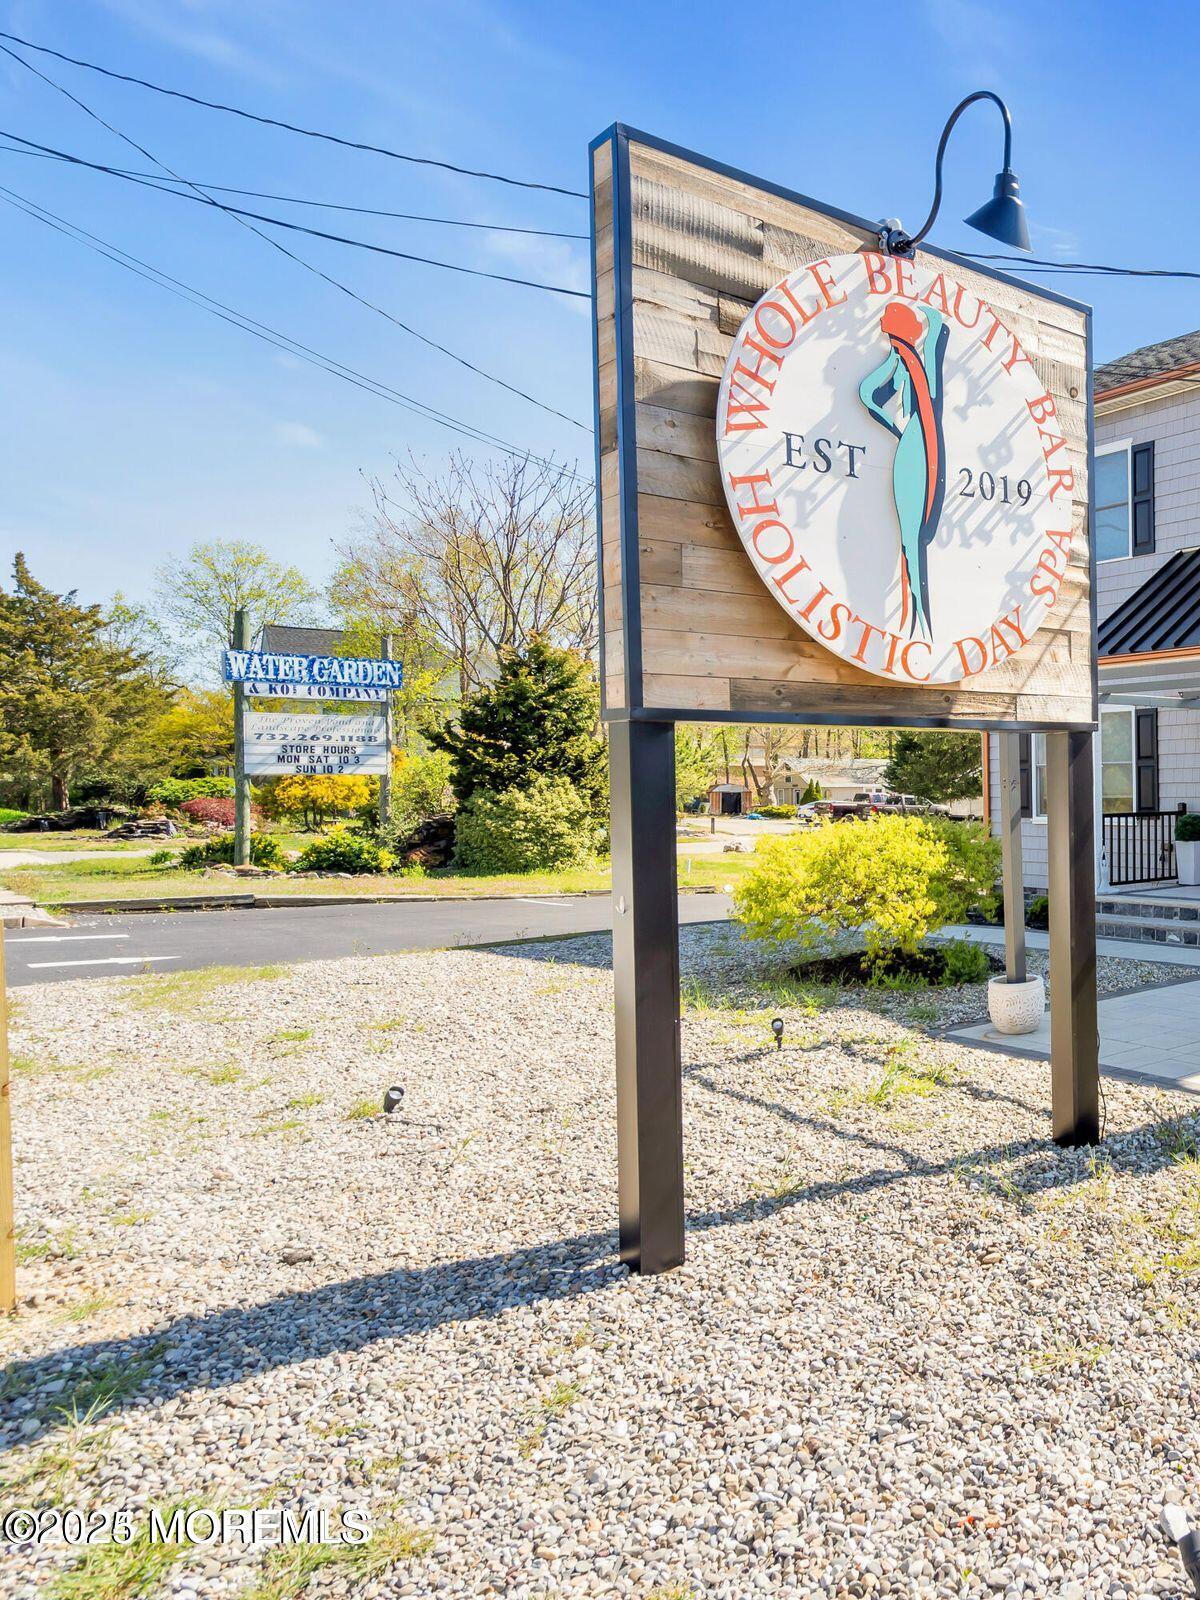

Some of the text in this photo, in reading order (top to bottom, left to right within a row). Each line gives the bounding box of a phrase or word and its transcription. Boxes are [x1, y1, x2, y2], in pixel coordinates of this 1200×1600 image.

[725, 251, 1075, 502] WHOLE BEAUTY BAR
[781, 431, 1033, 507] EST 2019
[728, 468, 1074, 682] HOLISTIC DAY SPA
[226, 651, 401, 688] WATER GARDEN
[249, 683, 260, 694] &
[307, 685, 383, 700] COMPANY
[259, 716, 276, 724] The
[325, 716, 352, 726] Pond
[354, 719, 375, 727] and
[251, 724, 313, 733] Landscape
[254, 732, 379, 743] 732.269.1188
[281, 745, 357, 755] STORE HOURS
[277, 755, 360, 764] MON SAT 10 3
[295, 765, 344, 774] SUN 10 2
